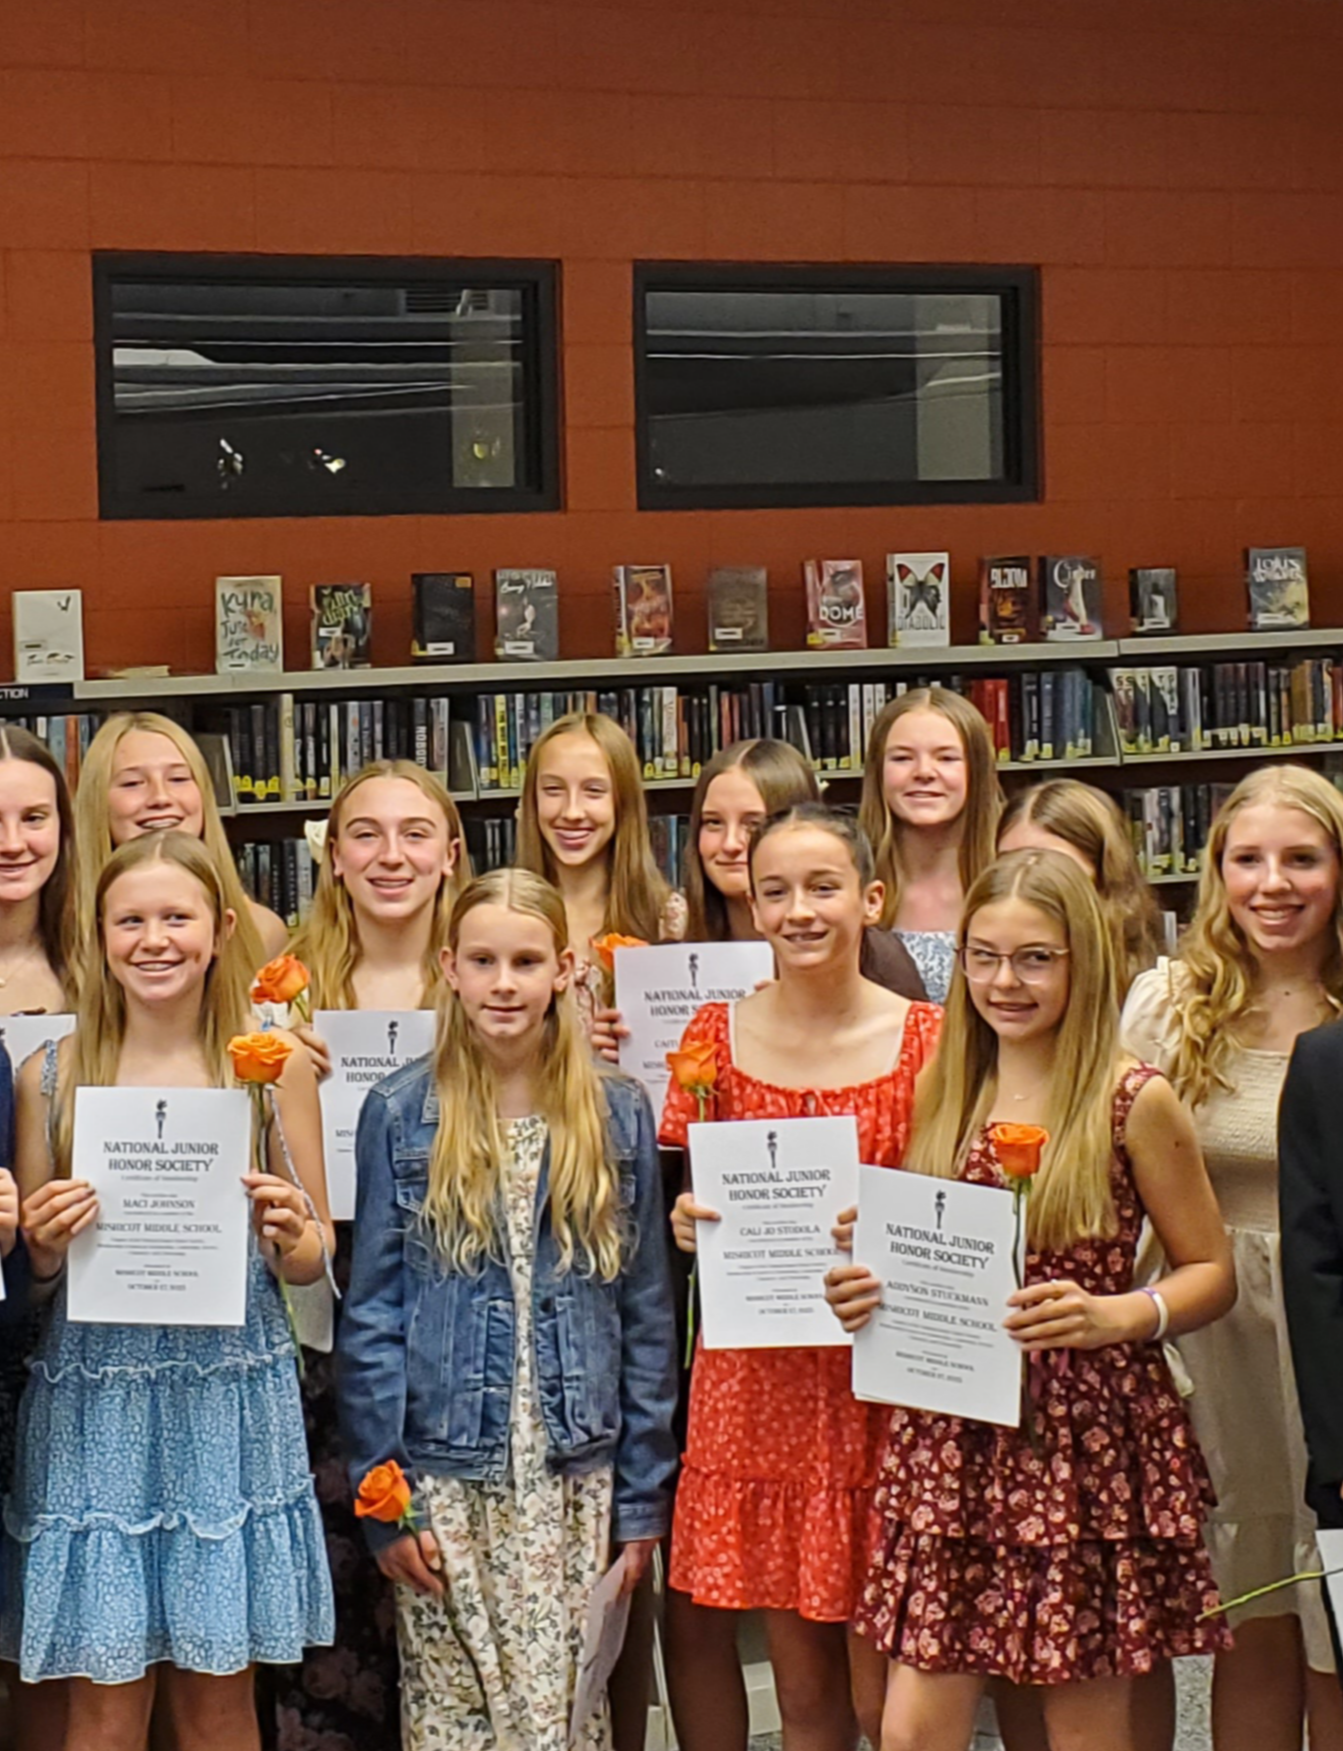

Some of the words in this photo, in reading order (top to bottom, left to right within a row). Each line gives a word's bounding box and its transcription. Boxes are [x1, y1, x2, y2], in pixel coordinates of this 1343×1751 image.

[819, 606, 864, 620] DOME
[644, 990, 702, 1002] NATIONAL
[705, 989, 746, 999] JUNIOR
[650, 1005, 689, 1016] HONOR
[341, 1057, 399, 1067] NATIONAL
[104, 1141, 169, 1154] NATIONAL
[171, 1143, 218, 1155] JUNIOR
[109, 1159, 152, 1171] HONOR
[155, 1158, 214, 1172] SOCIETY
[722, 1172, 783, 1185] NATIONAL
[786, 1170, 830, 1182] JUNIOR
[729, 1189, 770, 1201] HONOR
[772, 1185, 827, 1199] SOCIETY
[183, 1224, 222, 1233] SCHOOL
[886, 1224, 947, 1245] NATIONAL
[949, 1235, 994, 1254] JUNIOR
[891, 1241, 931, 1259] HONOR
[934, 1249, 989, 1269] SOCIETY
